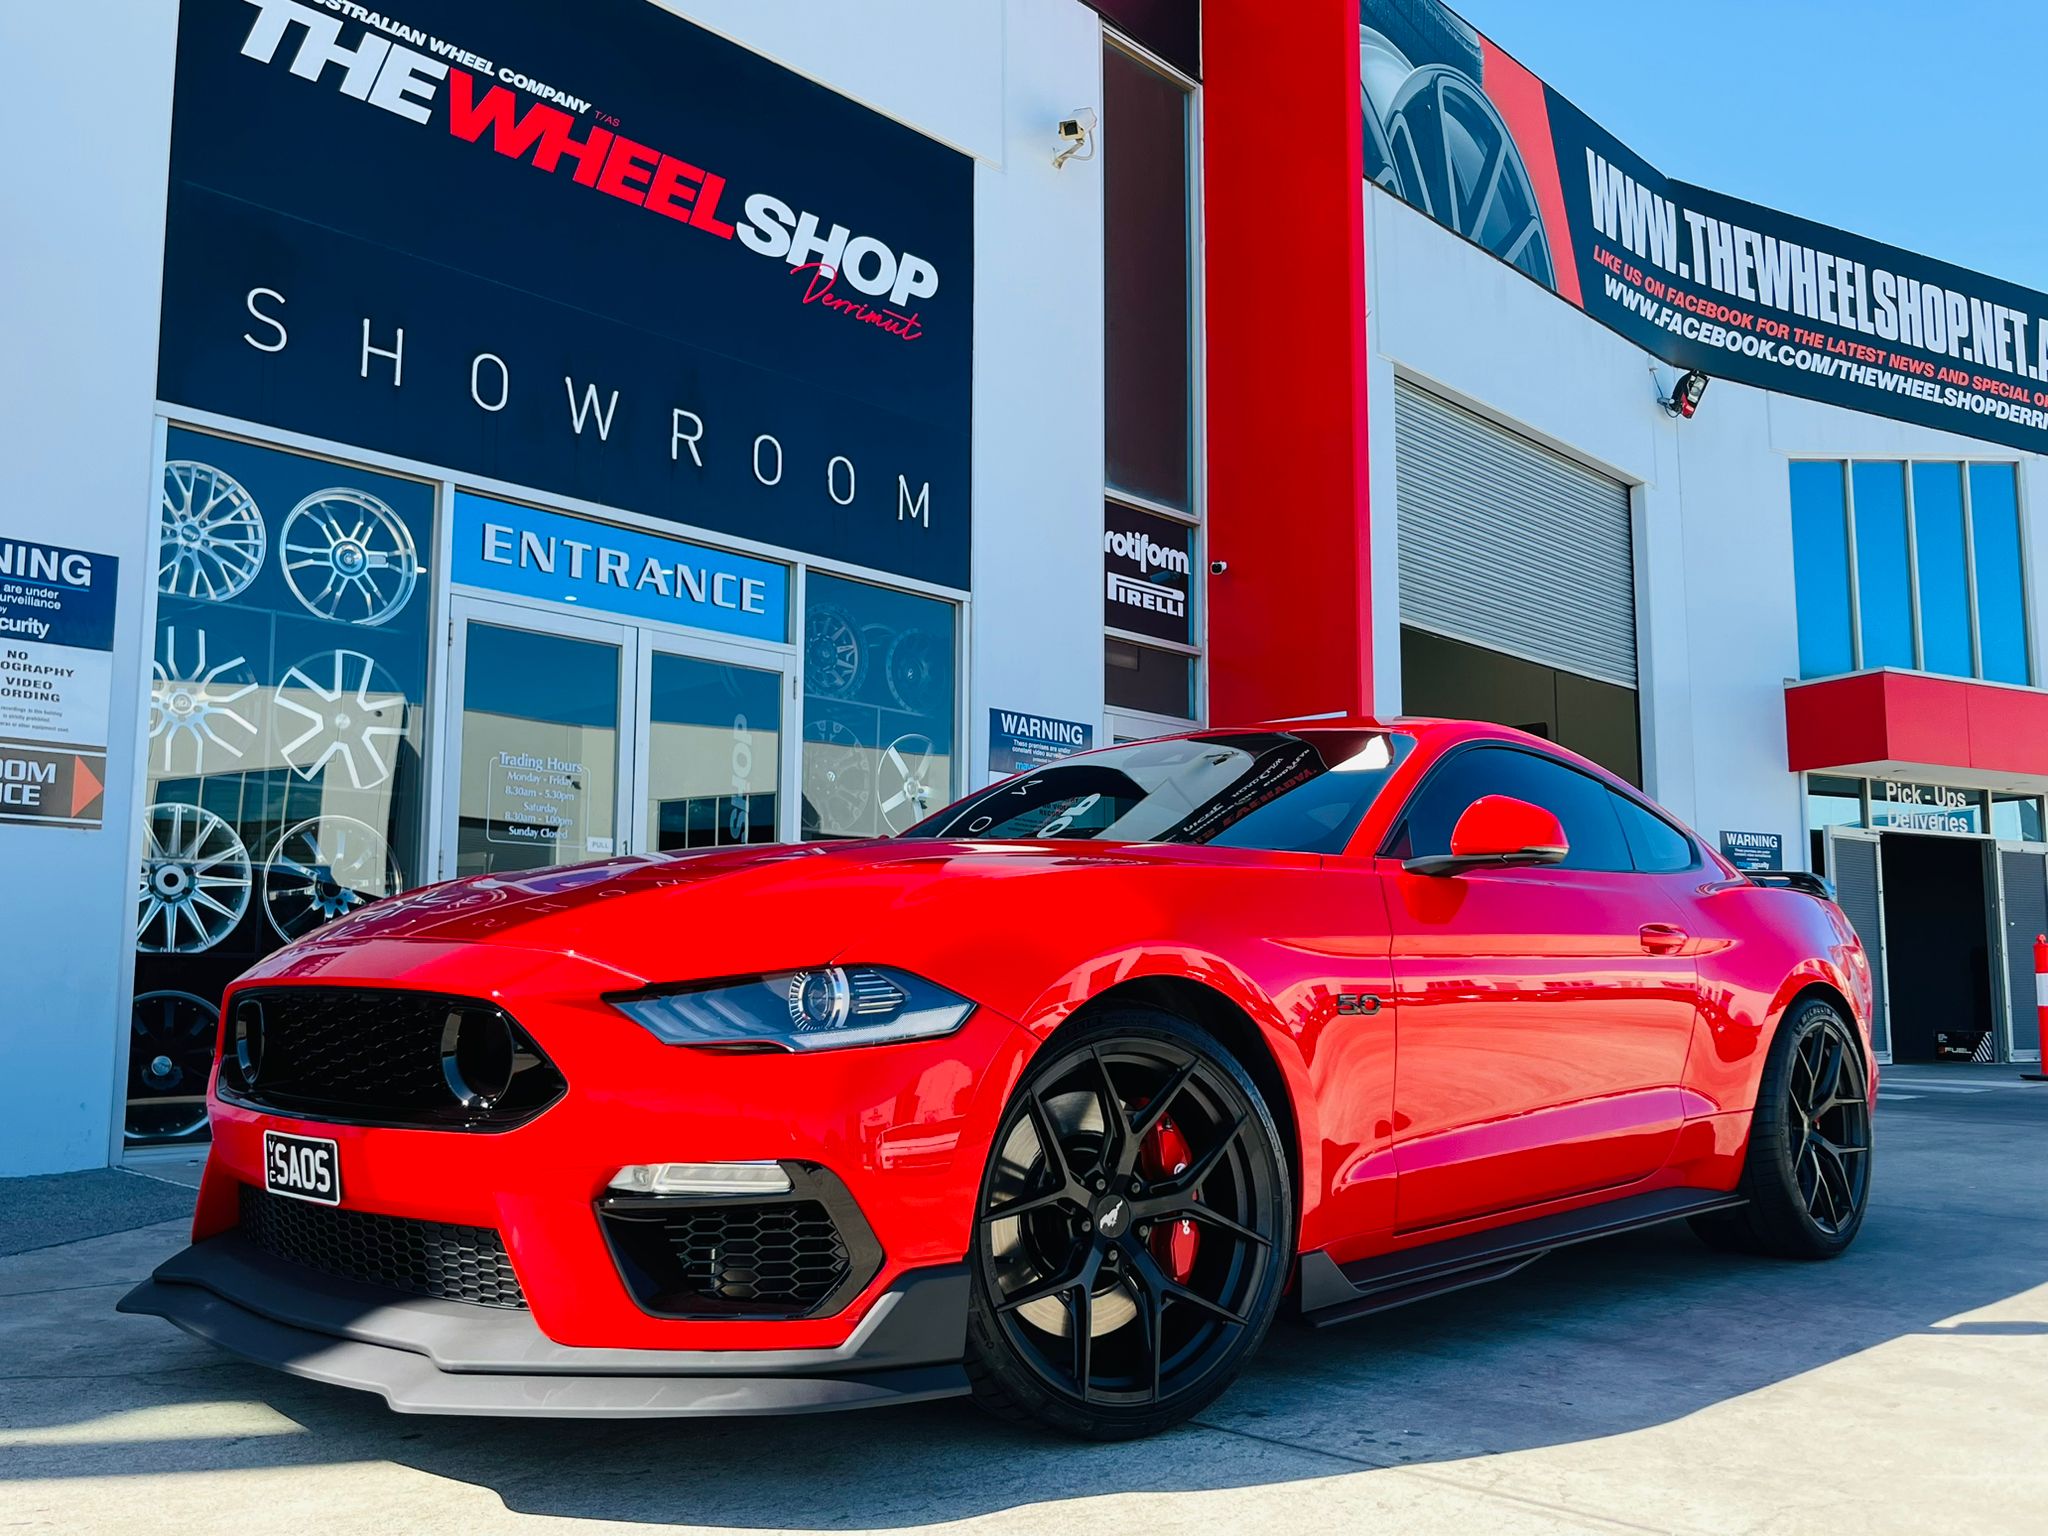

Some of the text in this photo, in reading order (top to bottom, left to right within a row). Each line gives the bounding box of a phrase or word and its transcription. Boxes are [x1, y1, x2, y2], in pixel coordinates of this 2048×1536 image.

[430, 36, 495, 77] WHEEL
[498, 67, 591, 115] COMPANY
[594, 110, 621, 127] T/AS
[1593, 244, 2048, 408] LIKE US ON FACEBOOK FOR THE LATEST NEWS AND SPECIAL O
[243, 287, 930, 528] SHOWROOM
[1104, 530, 1191, 575] rotiform
[482, 522, 766, 614] ENTRANCE
[3, 584, 60, 600] are under
[1107, 571, 1185, 618] PIRELLI
[7, 650, 29, 661] NO
[0, 660, 75, 678] OGRAPHY
[6, 676, 54, 690] VIDEO
[0, 687, 61, 703] ORDING
[1001, 712, 1084, 745] WARNING
[0, 758, 57, 784] OM
[499, 751, 583, 774] Trading Hours
[507, 771, 541, 784] Monday
[549, 775, 573, 788] Friday
[0, 782, 41, 806] CE
[505, 785, 537, 798] 8.30am
[544, 789, 575, 802] 5.30pm
[1885, 781, 1922, 805] Pick
[1934, 785, 1966, 811] Ups
[504, 811, 536, 824] 8.30am
[523, 801, 559, 814] Saturday
[1887, 808, 1968, 832] Deliveries
[508, 825, 568, 839] Sunday Closed
[1726, 832, 1778, 848] WARNING
